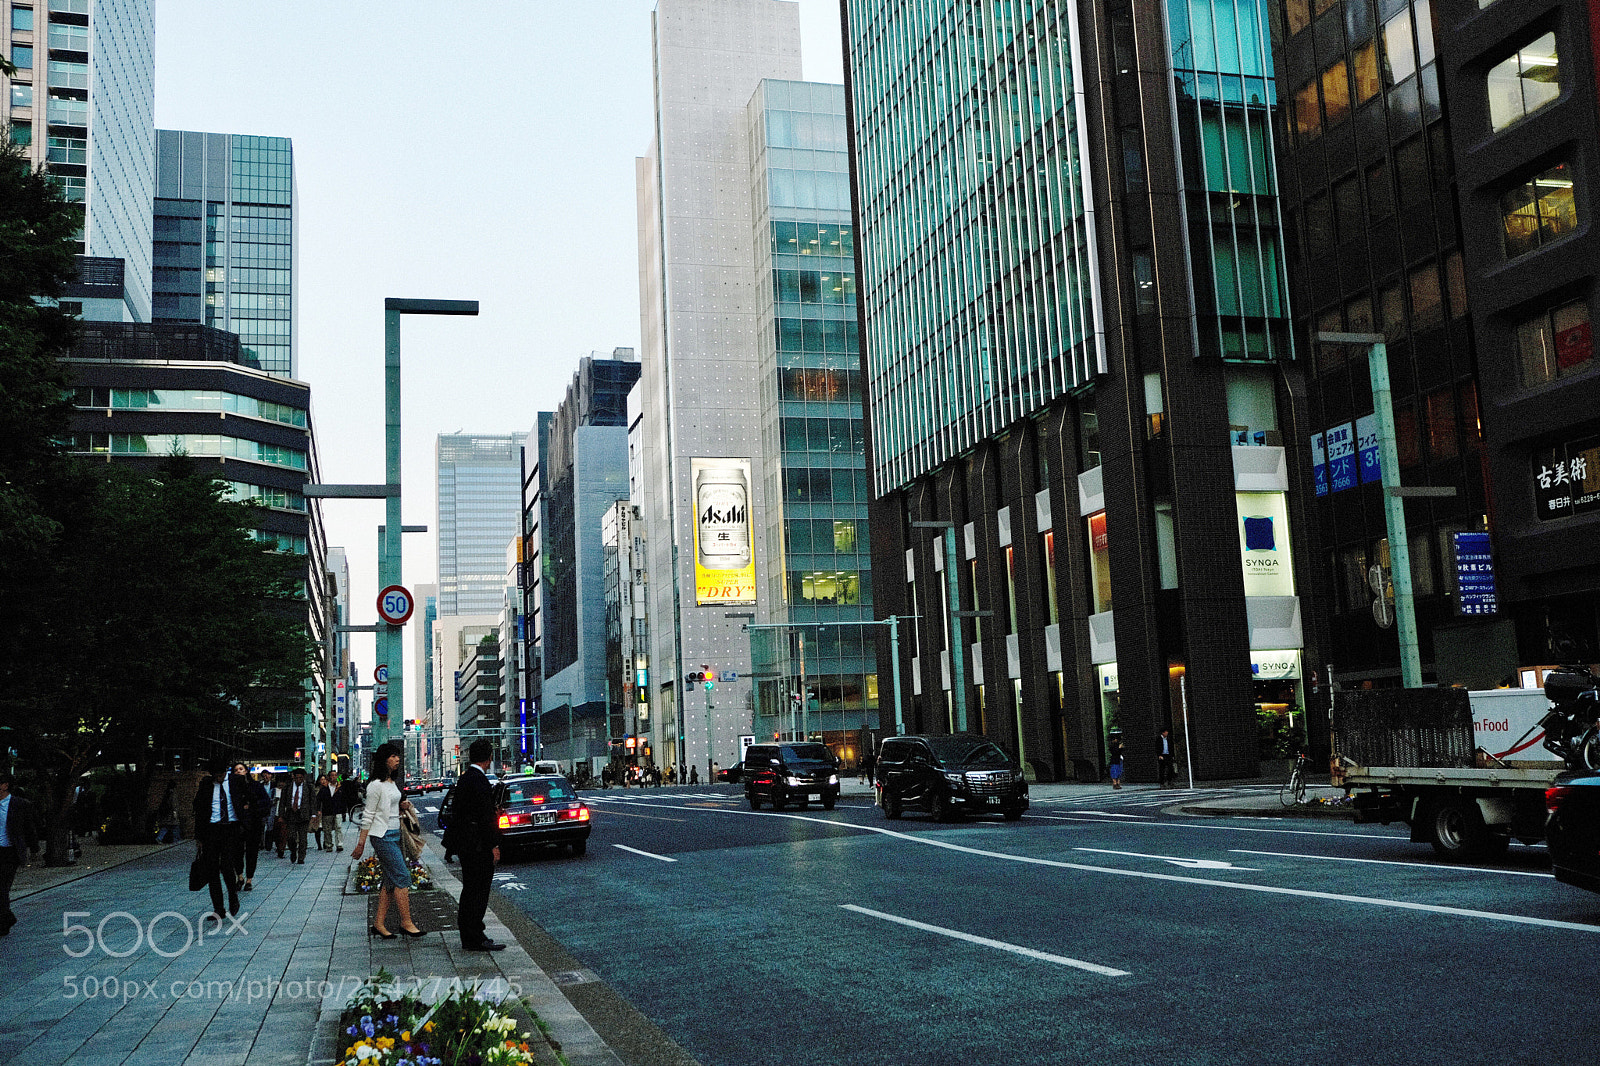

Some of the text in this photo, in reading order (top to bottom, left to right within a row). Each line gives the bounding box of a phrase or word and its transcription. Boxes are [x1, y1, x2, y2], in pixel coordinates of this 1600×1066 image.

[1536, 457, 1587, 489] 古美術
[1548, 496, 1571, 510] 春日井
[701, 505, 745, 524] Asahi
[718, 532, 730, 541] 生
[385, 595, 406, 613] 50
[1262, 662, 1296, 670] SYNQA
[1483, 718, 1509, 731] Food
